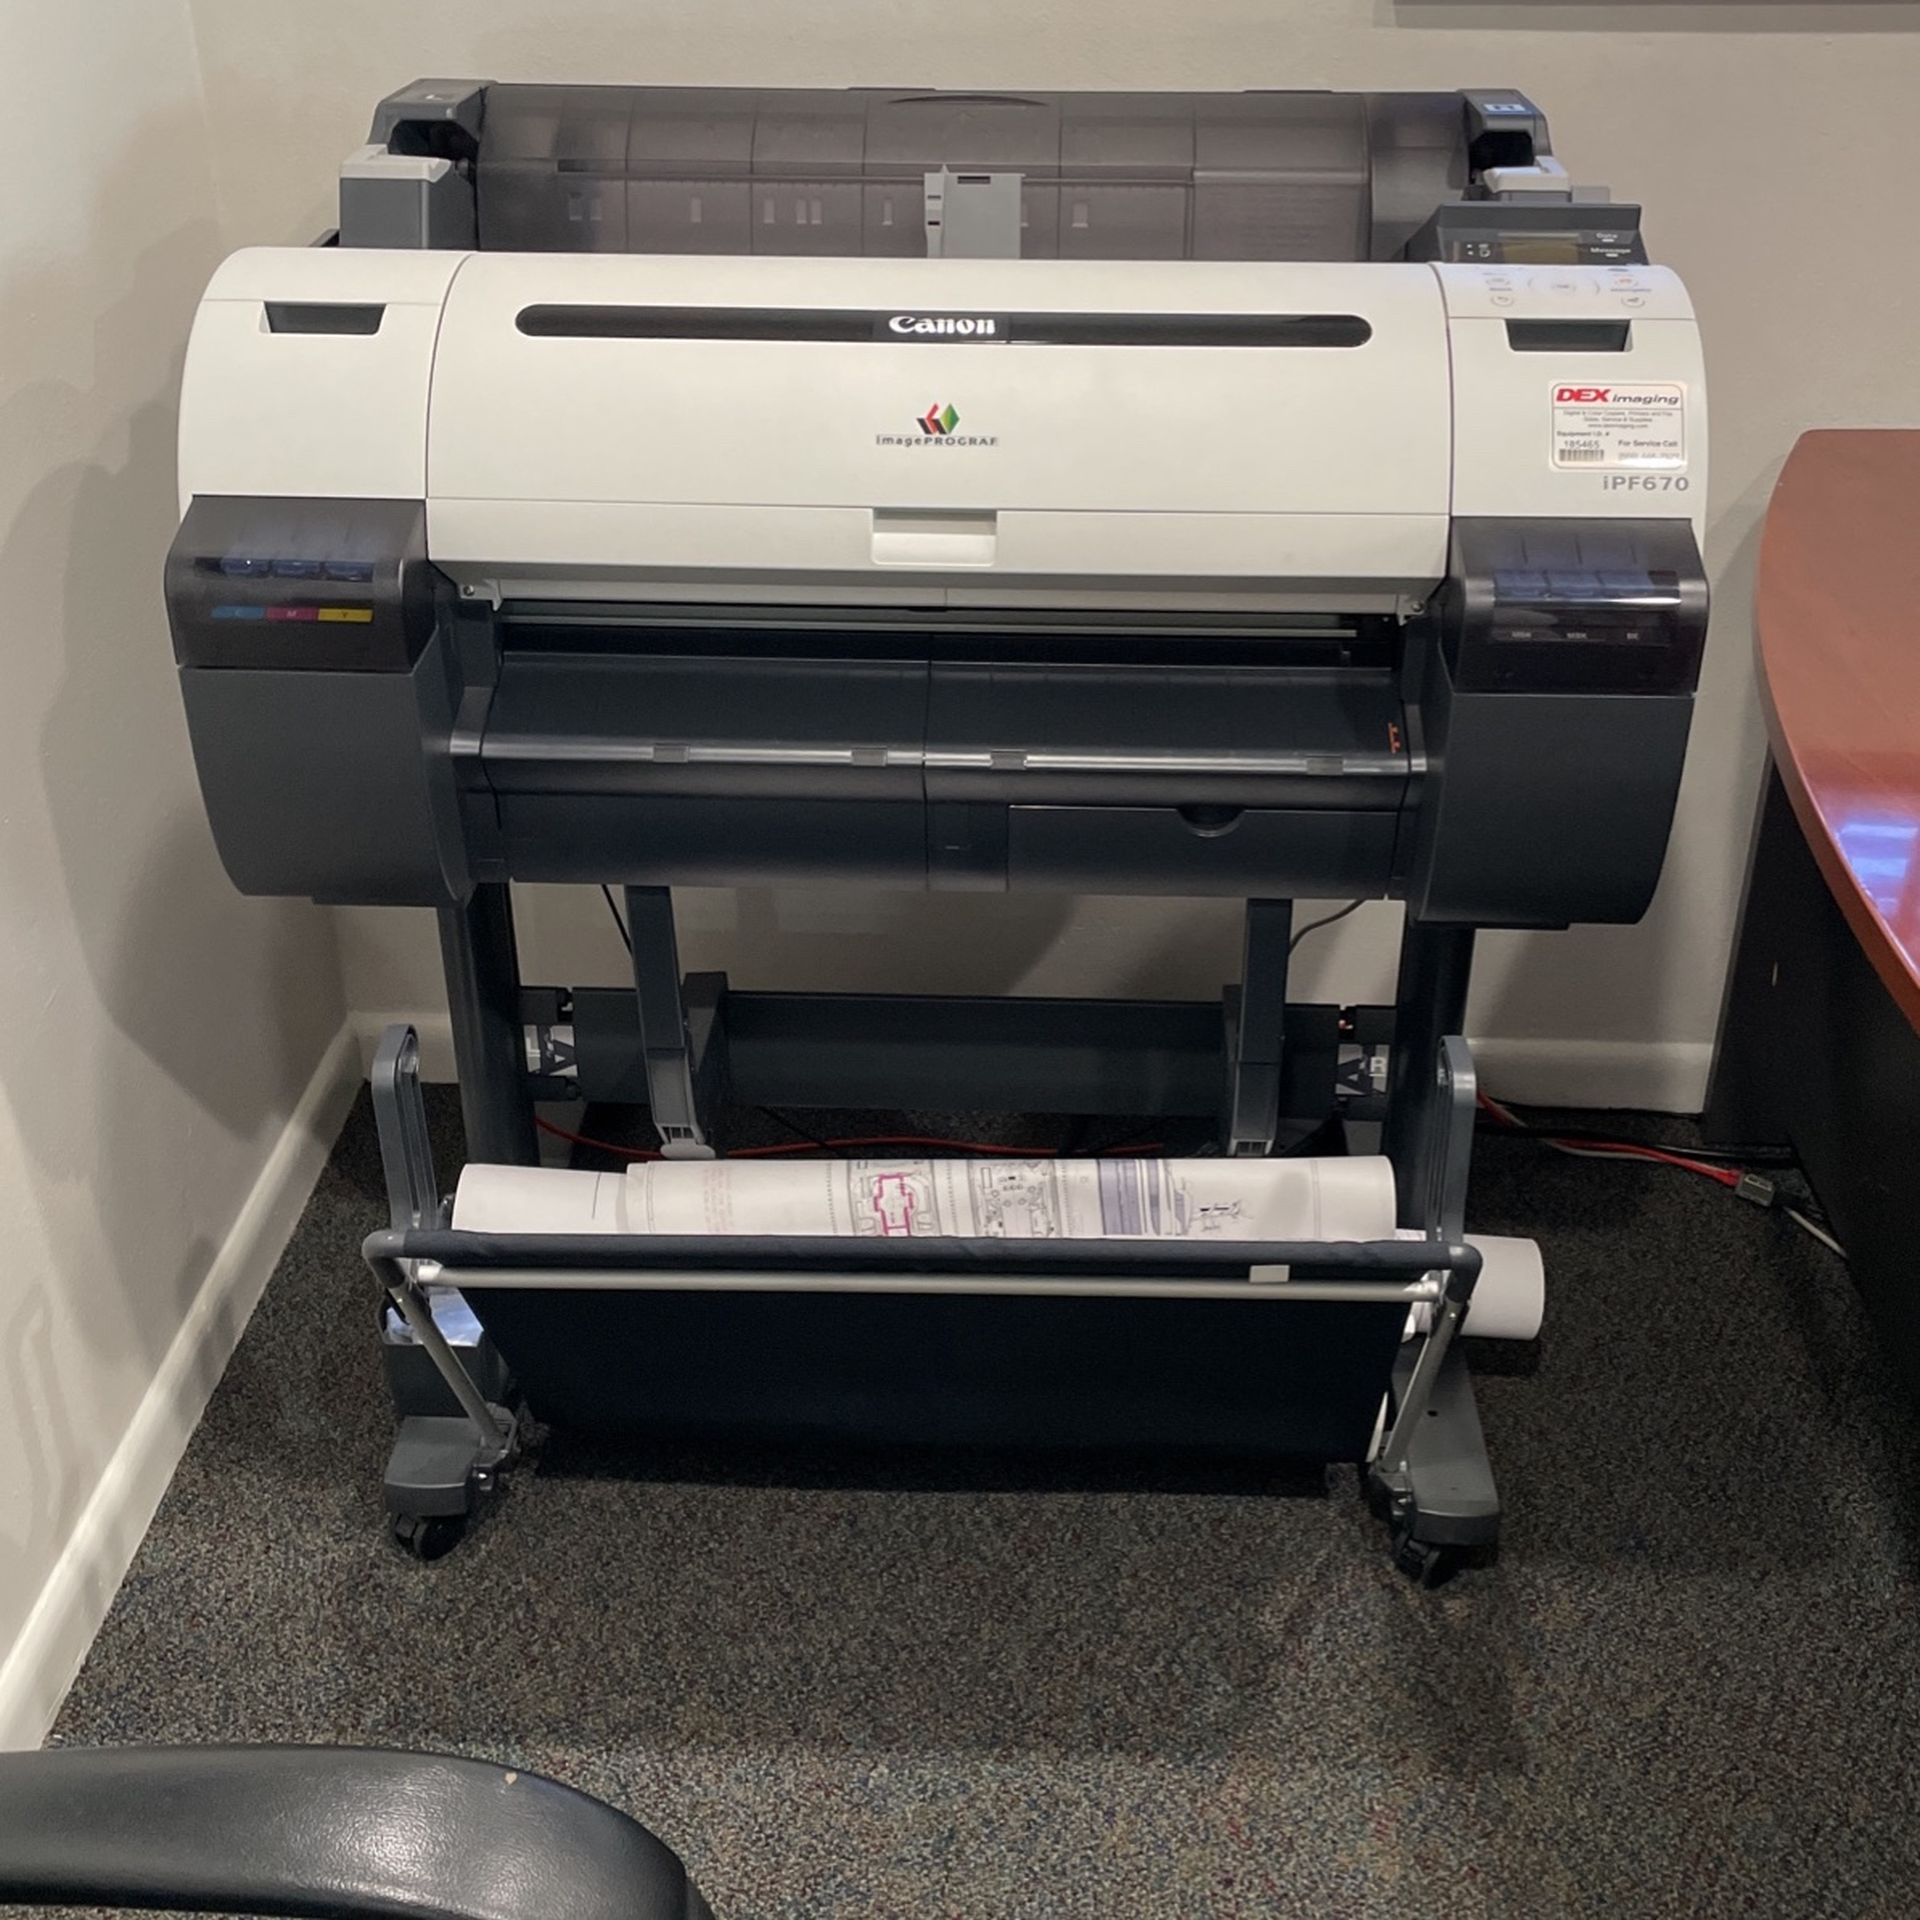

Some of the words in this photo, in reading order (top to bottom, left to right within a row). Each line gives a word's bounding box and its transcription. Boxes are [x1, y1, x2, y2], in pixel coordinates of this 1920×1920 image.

[889, 316, 995, 334] Canon
[1556, 388, 1611, 402] DEX
[1612, 394, 1679, 405] imaging
[876, 435, 999, 447] imagePROGRAF
[1603, 476, 1689, 491] iPF670
